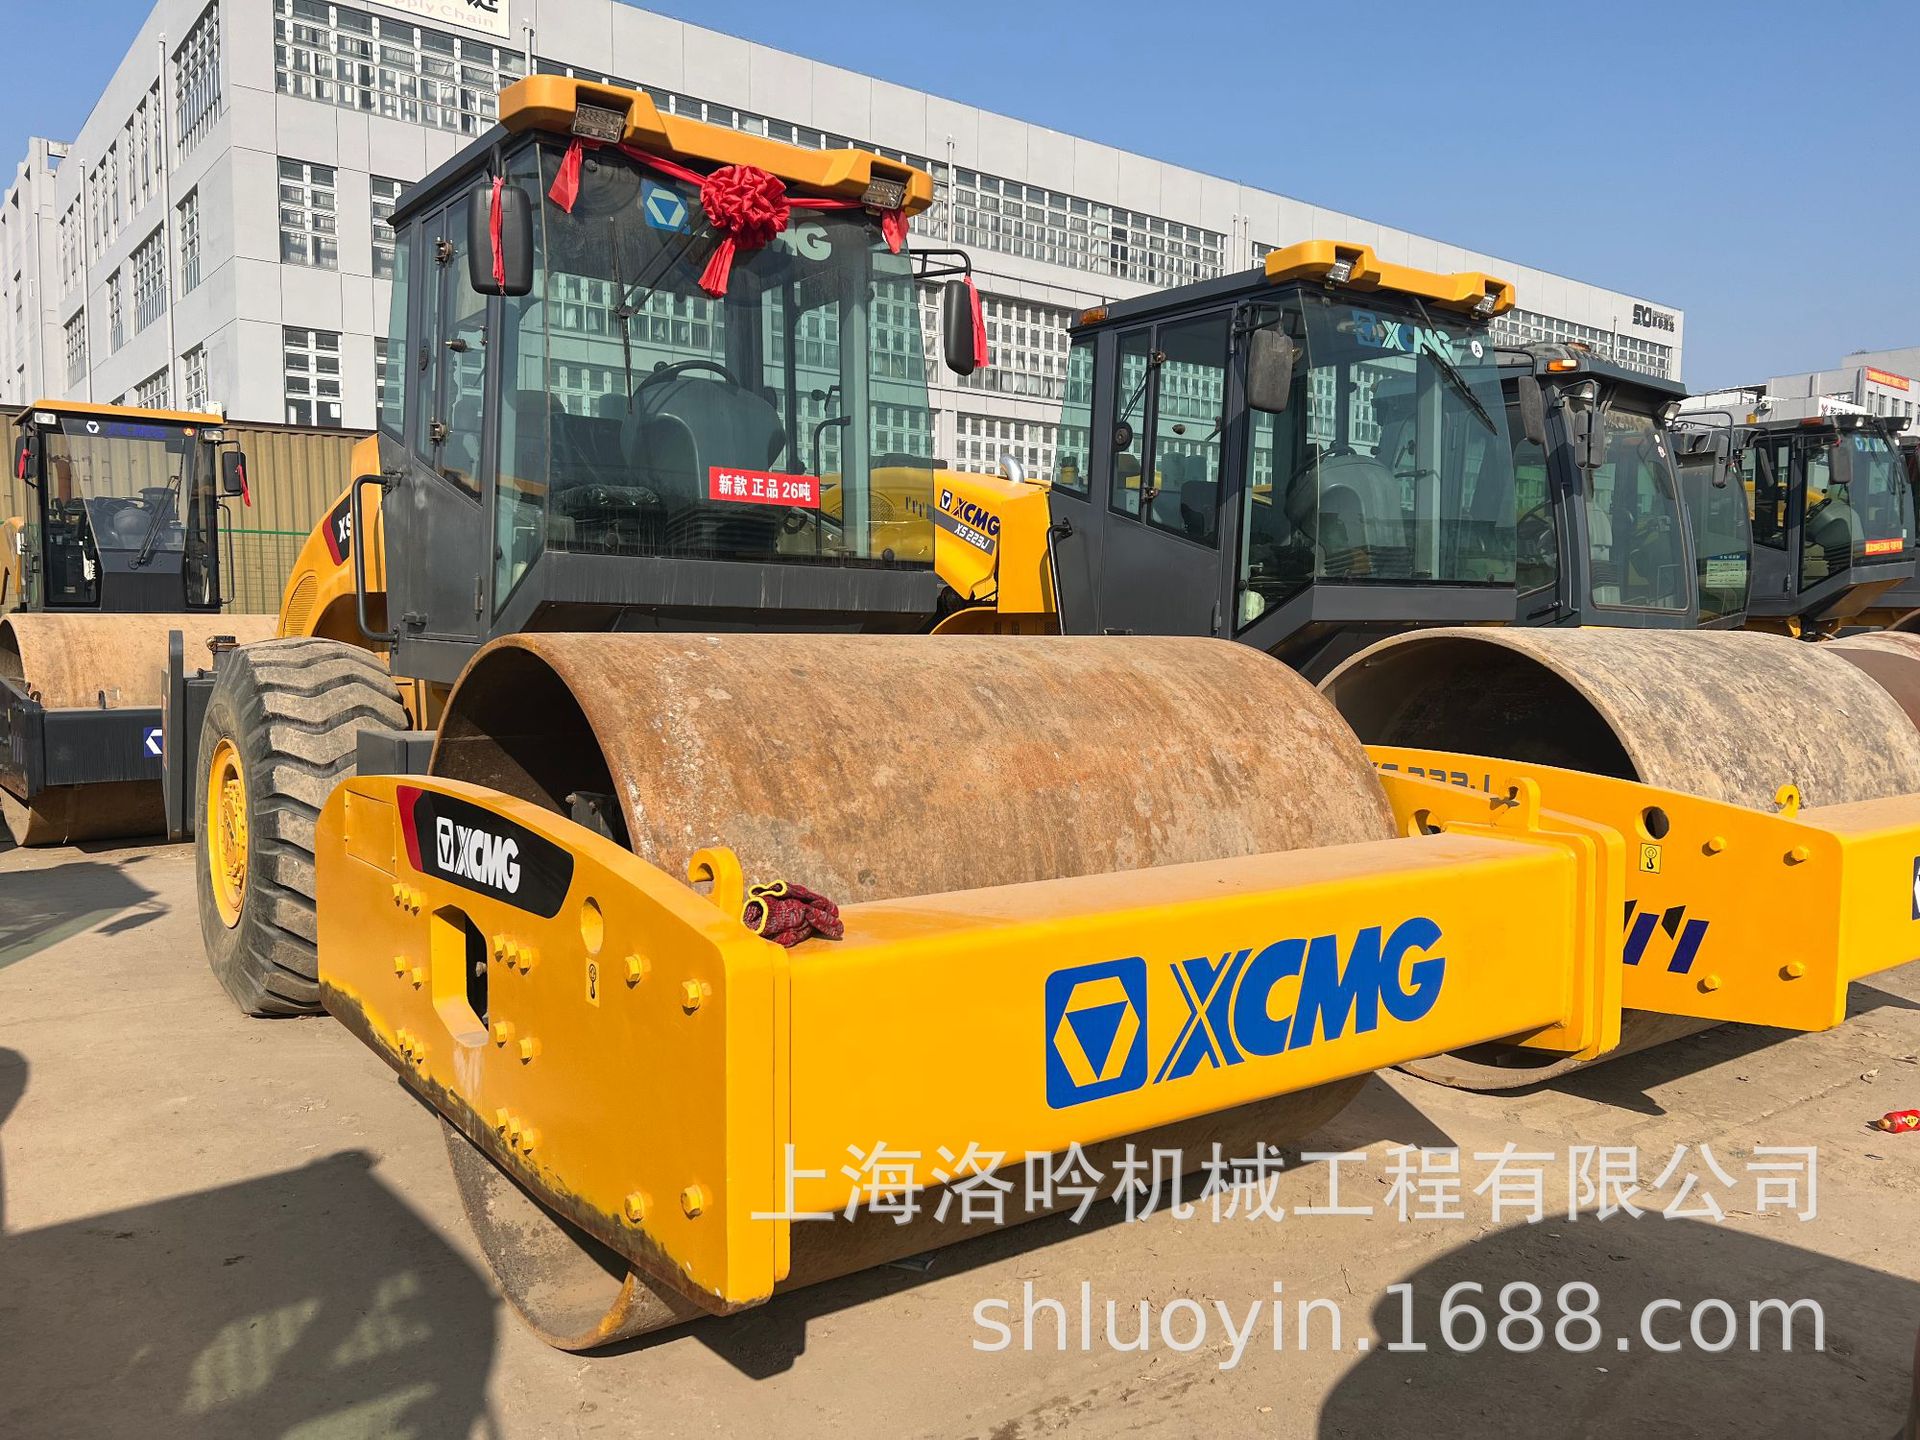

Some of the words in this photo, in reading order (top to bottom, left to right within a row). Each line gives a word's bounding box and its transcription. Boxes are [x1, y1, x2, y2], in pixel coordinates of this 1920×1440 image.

[440, 5, 494, 28] Chain
[718, 473, 748, 496] 新款
[752, 478, 779, 499] 正品
[782, 481, 811, 502] 26吨
[951, 496, 1000, 536] XCMG
[953, 523, 969, 538] XS
[456, 825, 521, 894] XCMG
[1153, 916, 1447, 1085] XCMG
